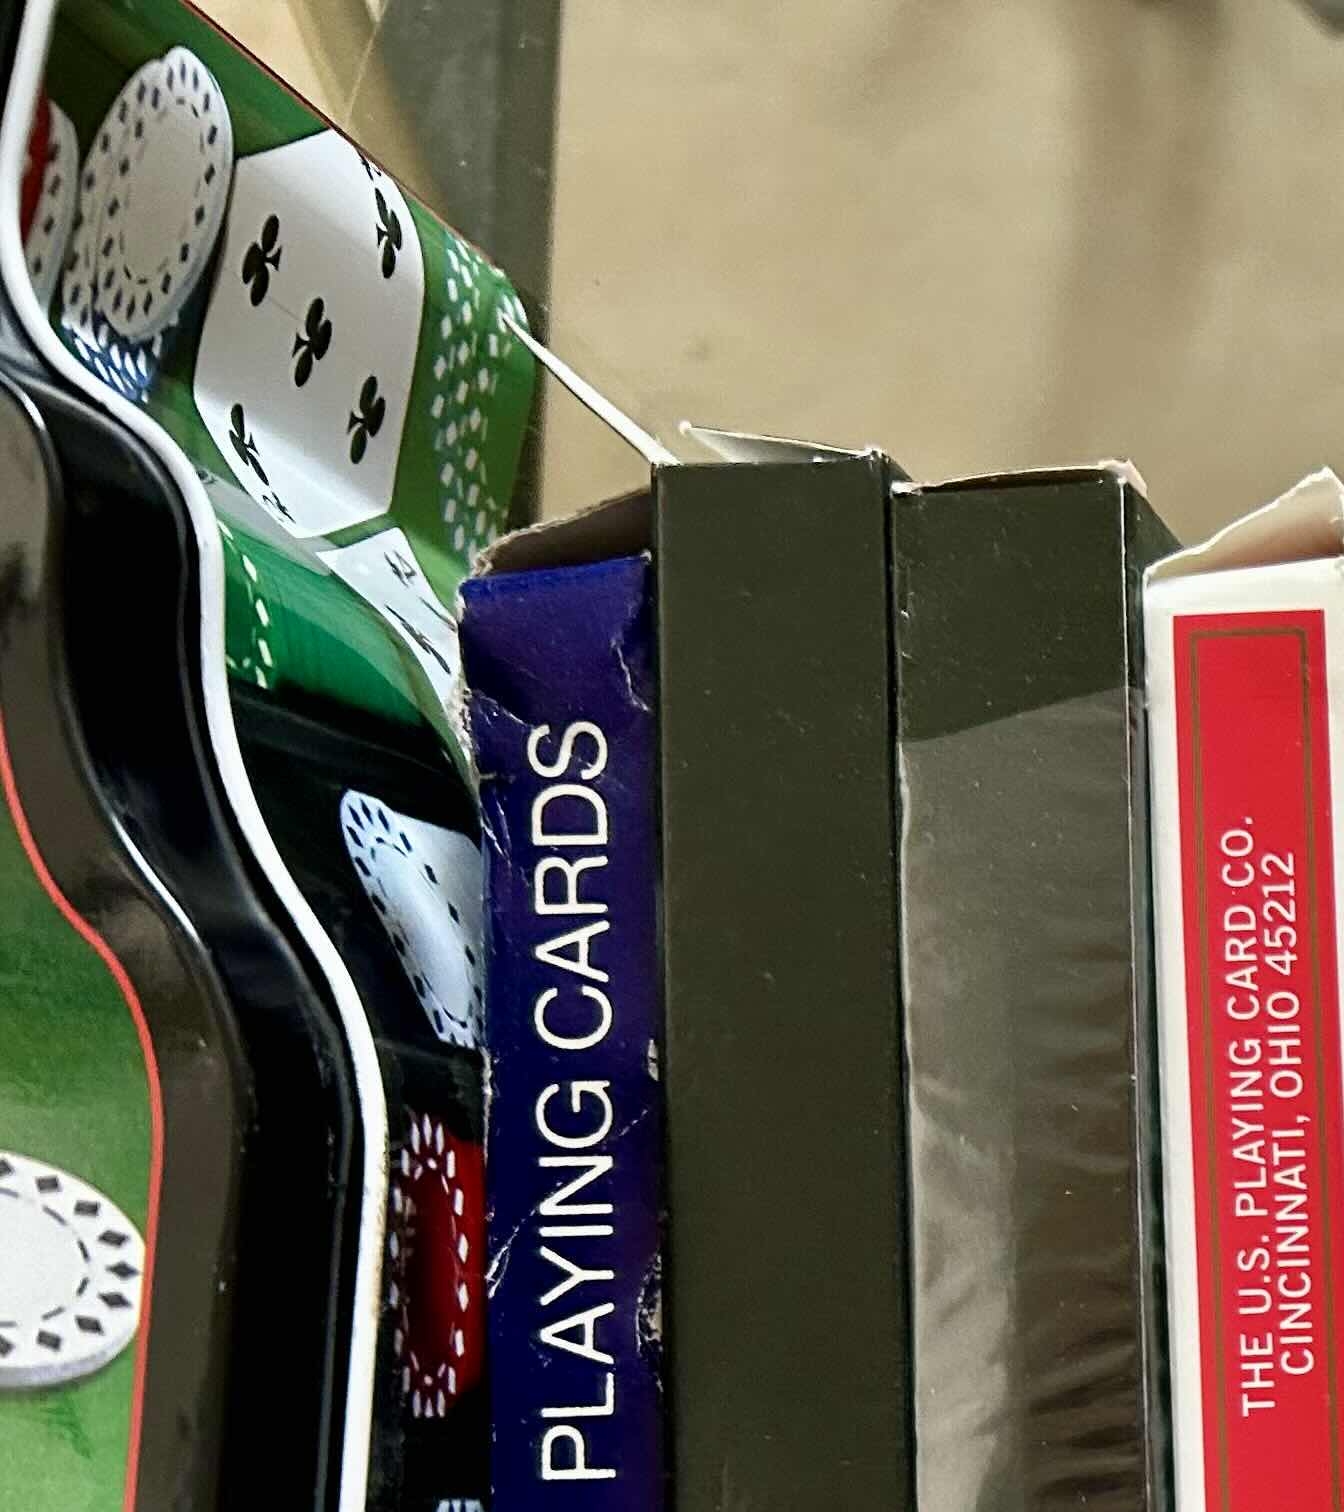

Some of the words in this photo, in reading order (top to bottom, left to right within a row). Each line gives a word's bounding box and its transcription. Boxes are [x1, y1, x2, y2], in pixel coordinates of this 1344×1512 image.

[527, 718, 613, 1050] CARDS
[1220, 816, 1254, 888] CO.
[1223, 904, 1260, 1020] CARD
[1260, 852, 1298, 976] 45212
[1266, 991, 1303, 1098] OHIO
[1228, 1038, 1267, 1217] PLAYING
[534, 1080, 617, 1481] PLAYING
[1237, 1244, 1272, 1315] U.S.
[1273, 1114, 1315, 1375] CINCINNATI,
[1242, 1332, 1275, 1417] THE
